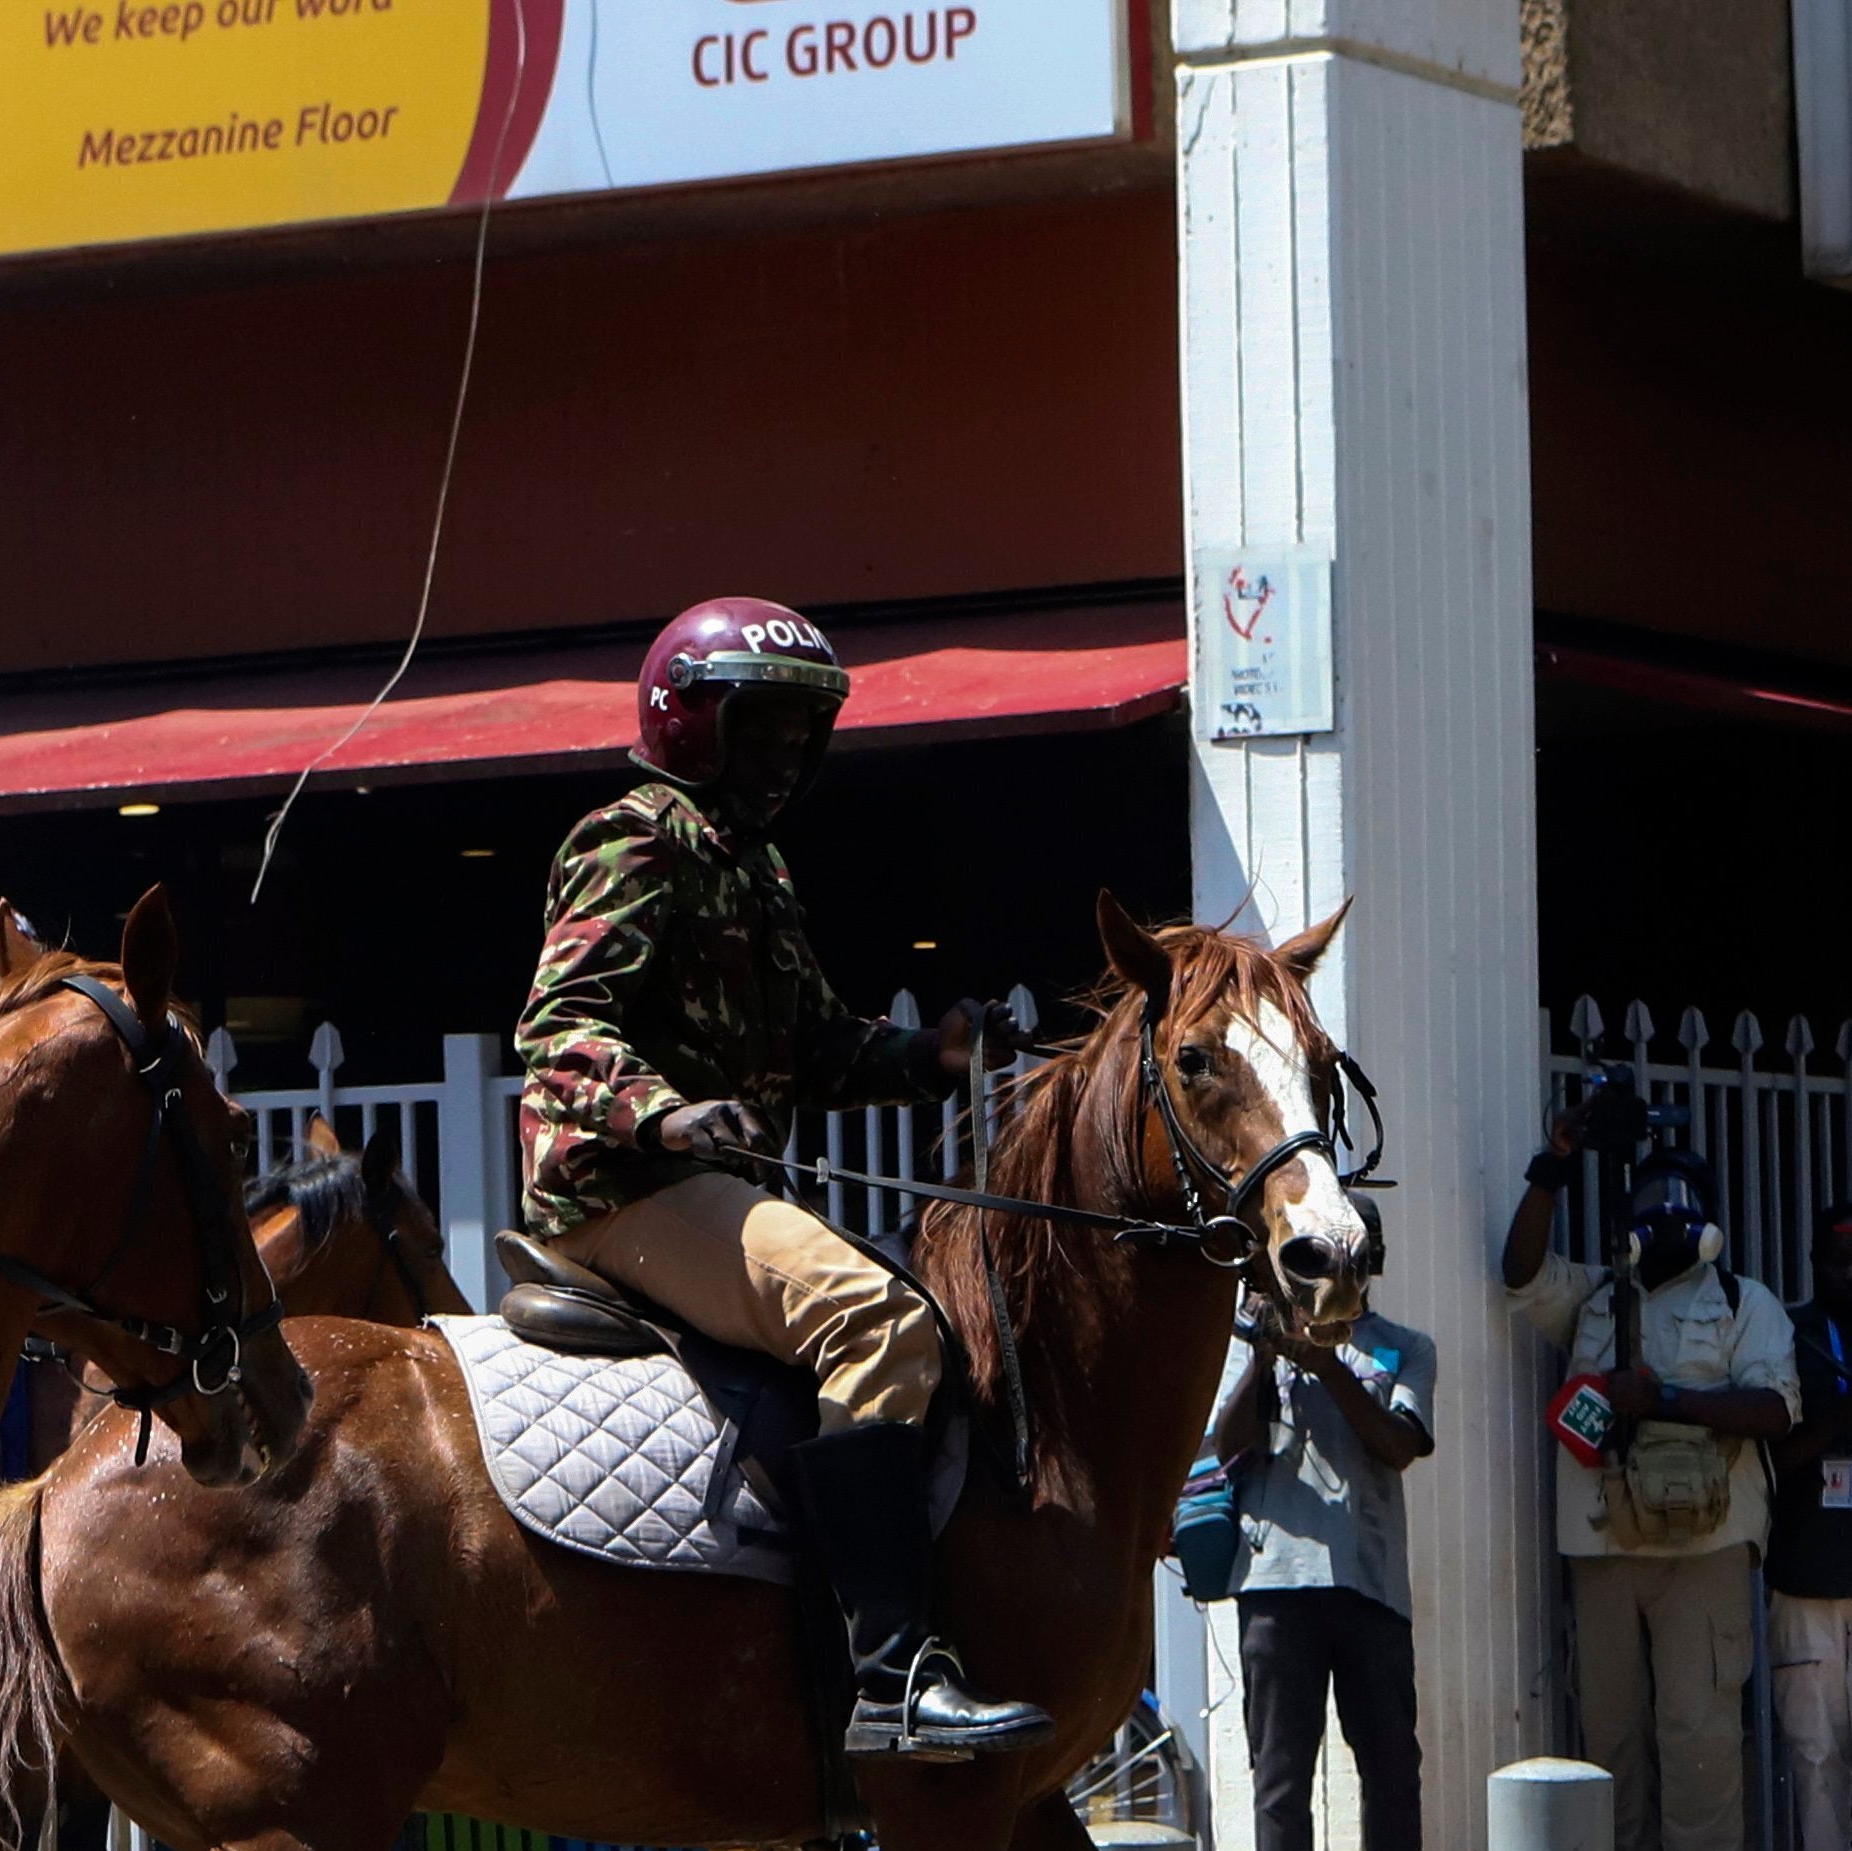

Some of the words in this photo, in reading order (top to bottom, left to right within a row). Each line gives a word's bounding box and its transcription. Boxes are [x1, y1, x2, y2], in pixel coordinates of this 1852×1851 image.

[44, 10, 103, 47] We
[114, 0, 205, 42] keep
[690, 28, 770, 88] CIC
[785, 6, 978, 78] GROUP
[77, 111, 284, 170] Mezzanine
[294, 102, 399, 147] Floor
